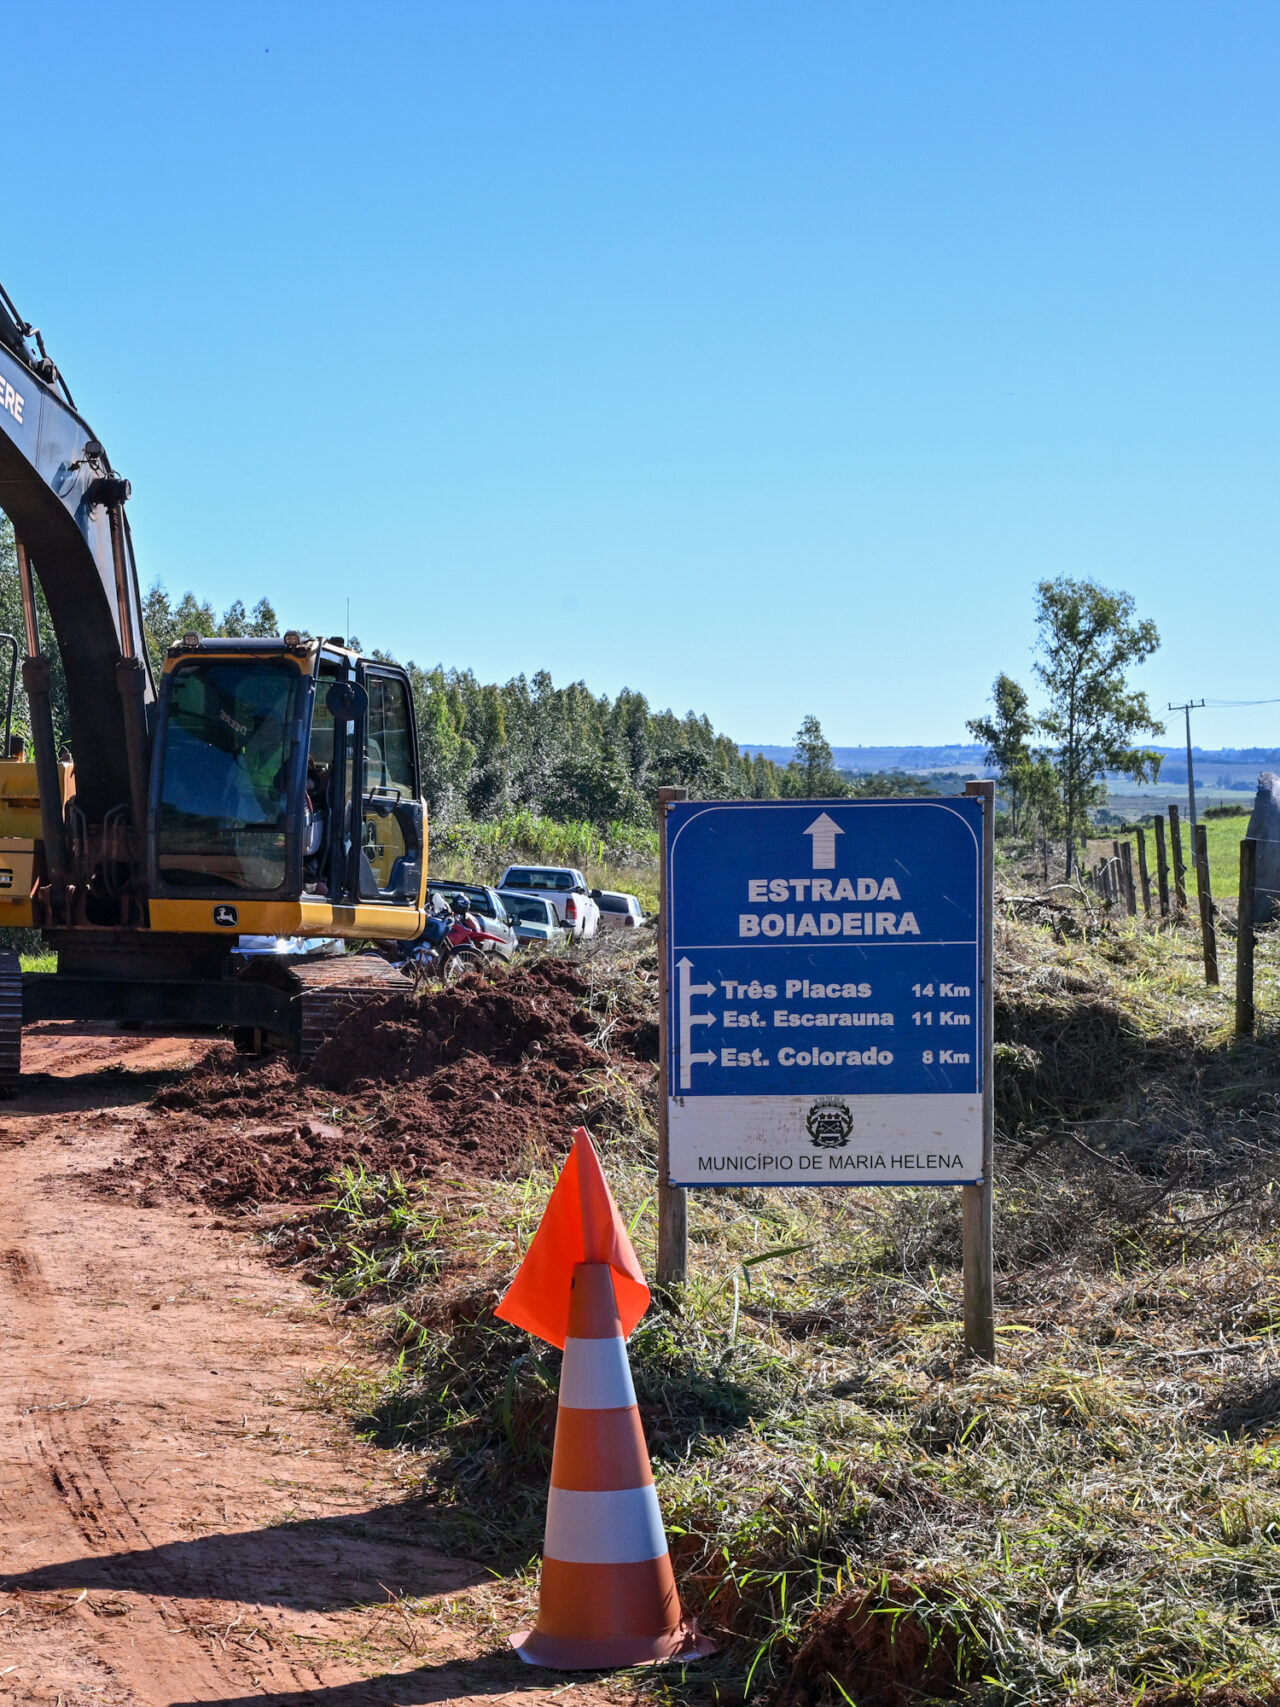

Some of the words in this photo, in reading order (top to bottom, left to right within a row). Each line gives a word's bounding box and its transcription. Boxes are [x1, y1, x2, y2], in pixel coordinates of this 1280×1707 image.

[748, 878, 902, 902] ESTRADA
[738, 912, 921, 937] BOIADEIRA
[721, 980, 778, 999] Três
[785, 979, 872, 998] Placas
[912, 984, 934, 997] 14
[939, 983, 971, 997] Km
[723, 1010, 766, 1028] Est.
[773, 1010, 894, 1027] Escarauna
[912, 1012, 933, 1025] 11
[939, 1011, 971, 1026] Km
[721, 1048, 770, 1067] Est.
[777, 1047, 894, 1066] Colorado
[922, 1050, 934, 1064] 8
[939, 1050, 970, 1064] Km
[698, 1153, 793, 1171] MUNICÍPIO
[799, 1156, 823, 1170] DE
[829, 1155, 886, 1170] MARIA
[890, 1154, 964, 1169] HELENA
